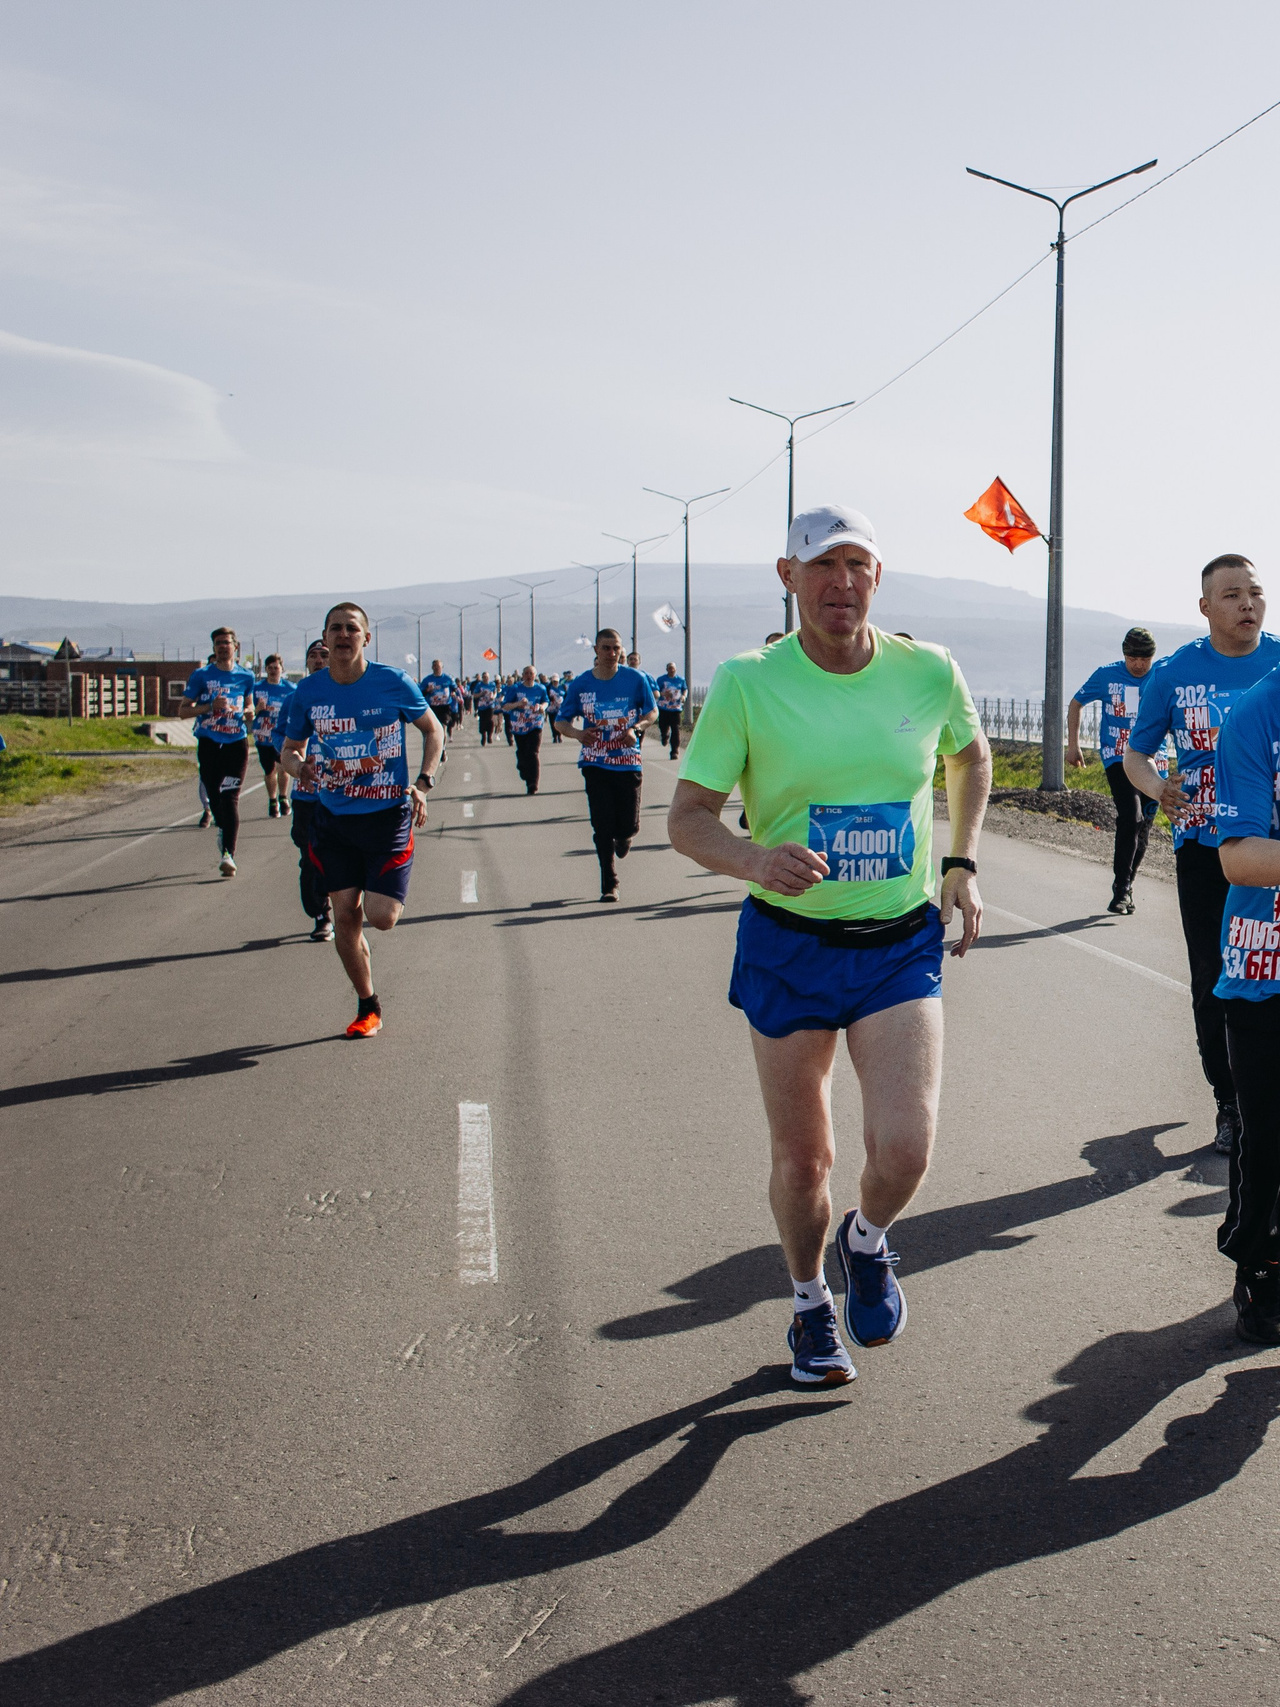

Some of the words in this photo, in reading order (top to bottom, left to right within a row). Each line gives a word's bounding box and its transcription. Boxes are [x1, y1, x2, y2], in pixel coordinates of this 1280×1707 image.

[1107, 682, 1125, 695] 202
[310, 705, 336, 720] 2024
[315, 718, 358, 733] #МЕЧТА
[335, 744, 368, 758] 20072
[832, 829, 896, 855] 40001
